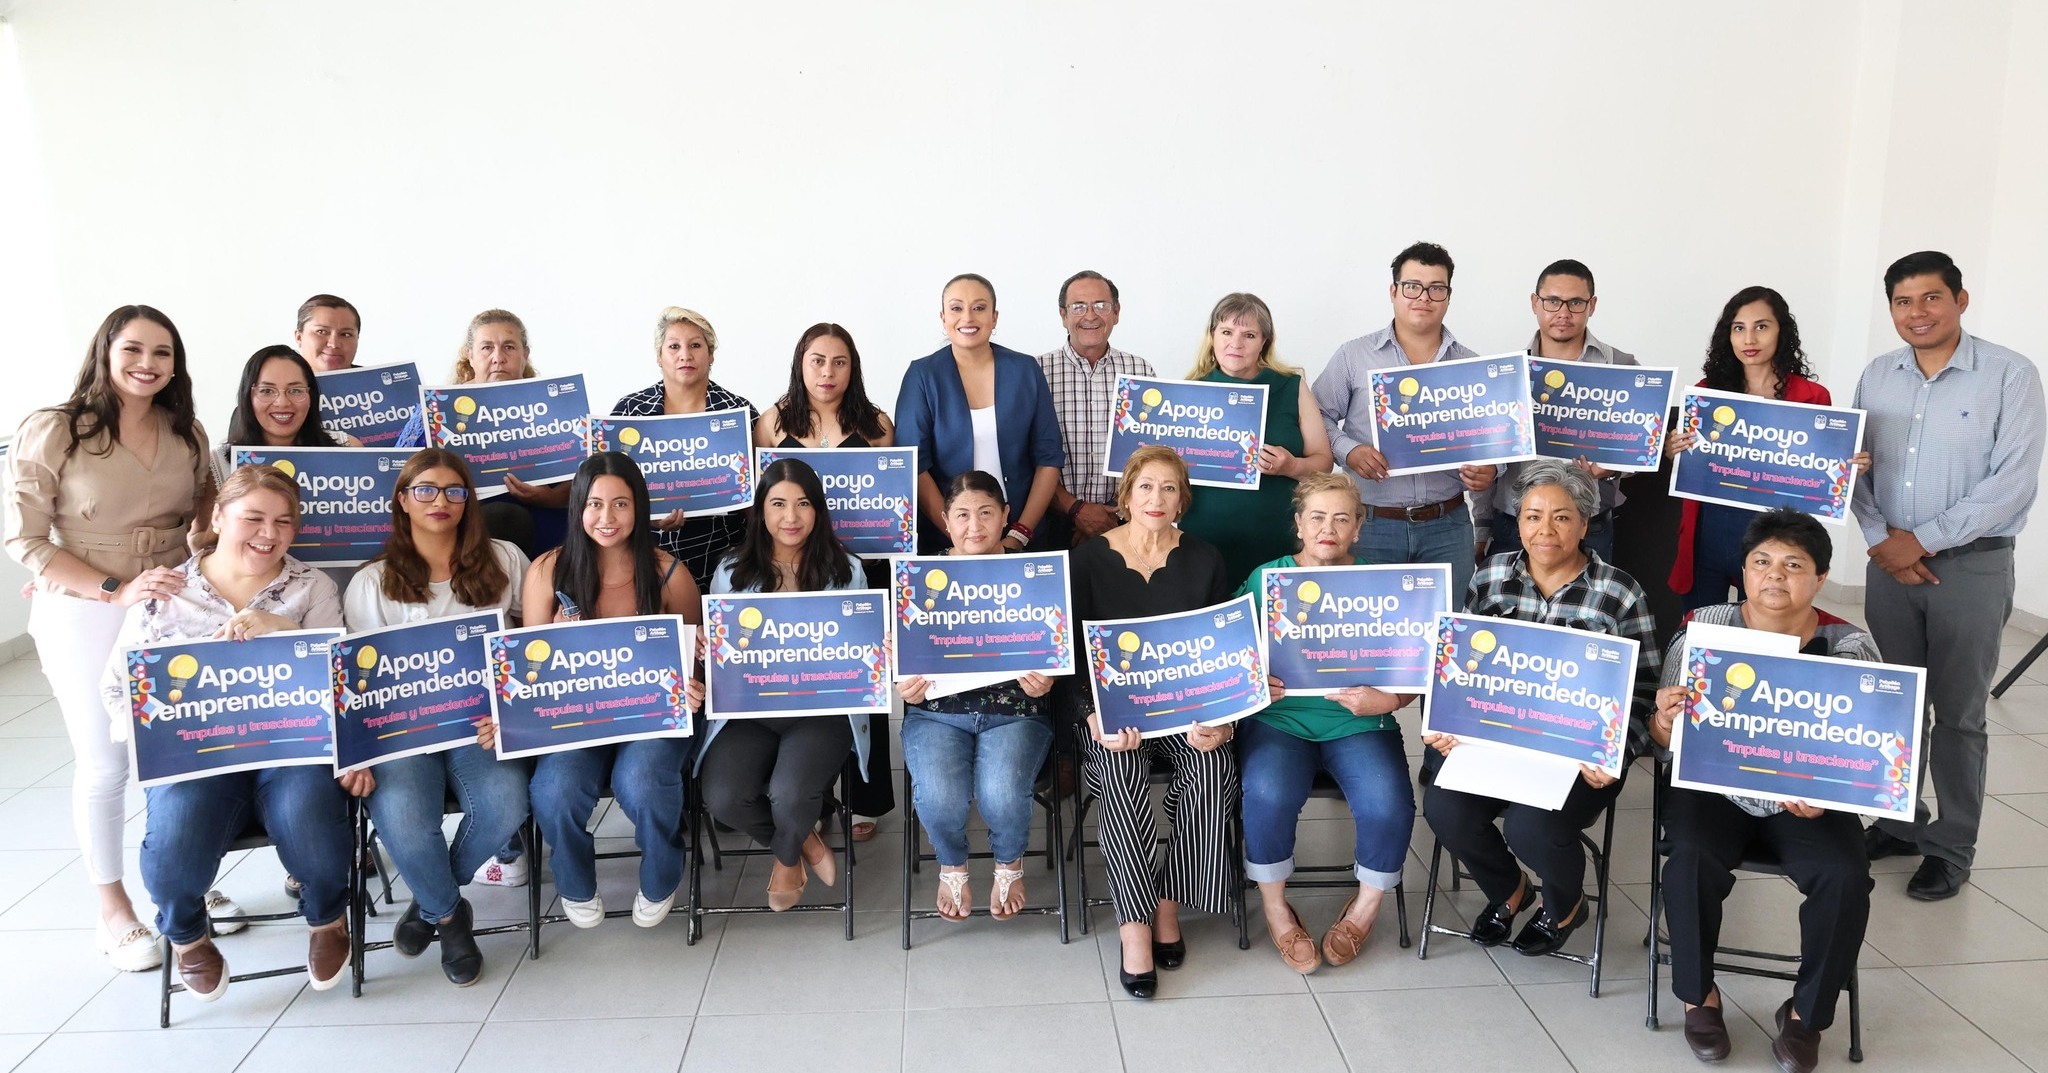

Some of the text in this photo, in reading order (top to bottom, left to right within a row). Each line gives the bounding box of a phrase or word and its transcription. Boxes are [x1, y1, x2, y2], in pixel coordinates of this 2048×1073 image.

[319, 391, 384, 415] Apoyo
[1418, 382, 1487, 407] Apoyo
[1560, 382, 1630, 407] Apoyo
[319, 405, 415, 430] prendedor
[476, 402, 548, 426] Apoyo
[1158, 400, 1224, 424] Apoyo
[1393, 400, 1516, 429] emprendedor
[1532, 402, 1655, 425] emprendedor
[450, 418, 580, 449] emprendedor
[1130, 421, 1250, 442] emprendedor
[1448, 431, 1455, 441] y
[1579, 430, 1586, 439] y
[1731, 418, 1809, 448] Apoyo
[510, 450, 517, 460] y
[639, 436, 708, 458] Apoyo
[1700, 440, 1839, 471] emprendedor
[636, 452, 738, 477] prendedor
[1752, 471, 1760, 481] y
[297, 472, 375, 496] Apoyo
[814, 471, 875, 493] poyo
[825, 493, 902, 510] endedor
[946, 581, 1022, 606] Apoyo
[1319, 592, 1399, 619] Apoyo
[916, 603, 1054, 630] emprendedor
[761, 619, 839, 644] Apoyo
[975, 635, 983, 646] y
[1288, 617, 1433, 644] emprendedor
[550, 647, 633, 674] Apoyo
[730, 642, 872, 669] emprendedor
[1141, 635, 1215, 664] Apoyo
[1349, 649, 1357, 660] y
[376, 648, 455, 680] Apoyo
[1114, 650, 1248, 689] emprendedor
[1492, 645, 1579, 681] Apoyo
[197, 663, 293, 692] Apoyo
[350, 668, 488, 710] emprendedor
[518, 666, 670, 700] emprendedor
[791, 674, 799, 685] y
[1175, 691, 1184, 701] y
[1455, 671, 1613, 710] emprendedor
[1750, 680, 1853, 719] Apoyo
[157, 686, 330, 722] emprendedor
[409, 709, 418, 721] y
[585, 703, 594, 714] y
[1517, 708, 1526, 720] y
[237, 724, 247, 735] y
[1709, 710, 1896, 748] emprendedor
[1783, 751, 1793, 762] y
